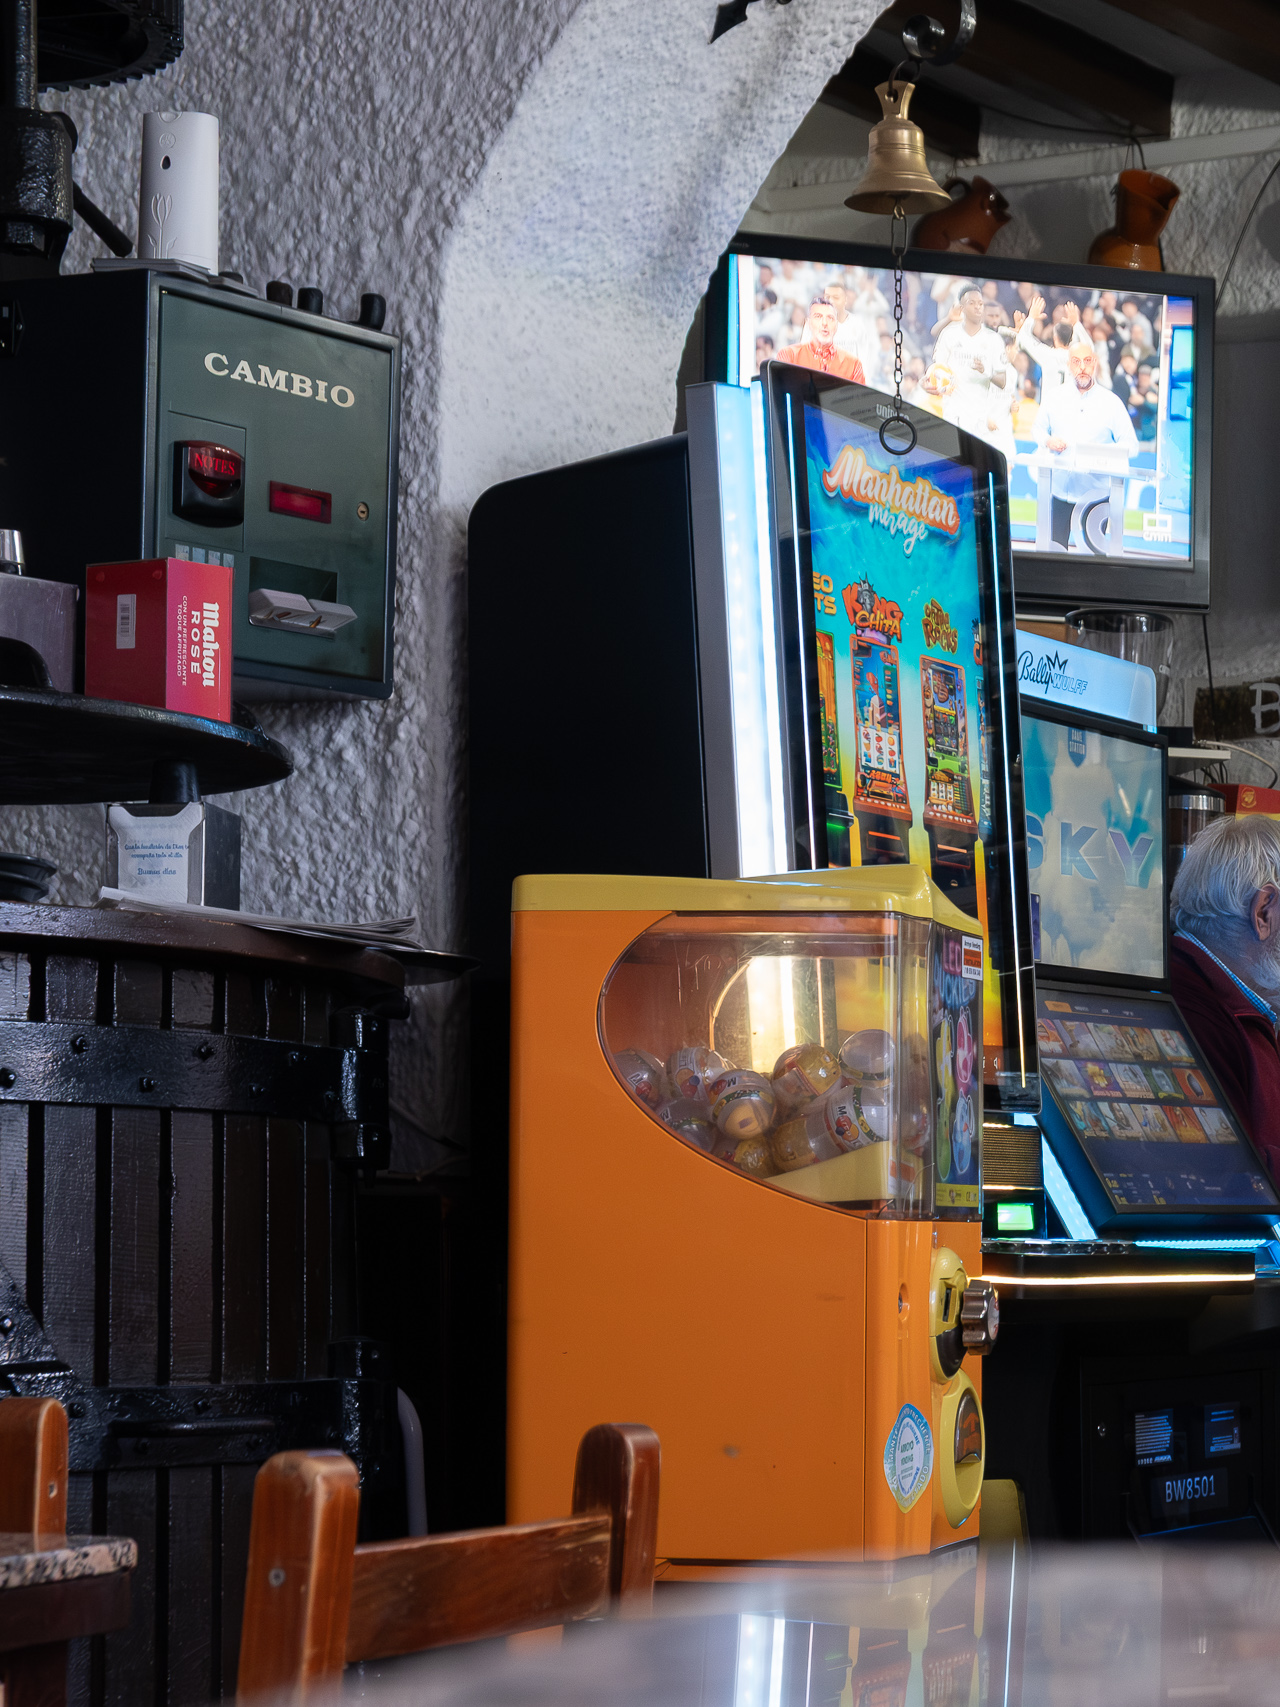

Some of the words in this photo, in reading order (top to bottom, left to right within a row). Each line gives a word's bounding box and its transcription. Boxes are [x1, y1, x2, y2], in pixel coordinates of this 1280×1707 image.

[204, 352, 355, 407] CAMBIO
[194, 452, 235, 476] NOTES
[826, 450, 957, 526] Manhattan
[869, 502, 928, 554] mirage
[812, 571, 834, 595] EO
[182, 614, 187, 627] UN
[813, 592, 838, 616] TS
[202, 602, 220, 688] Mahou
[1017, 650, 1053, 694] Bally
[1052, 672, 1088, 695] WULFF
[1165, 1474, 1216, 1503] BW8501
